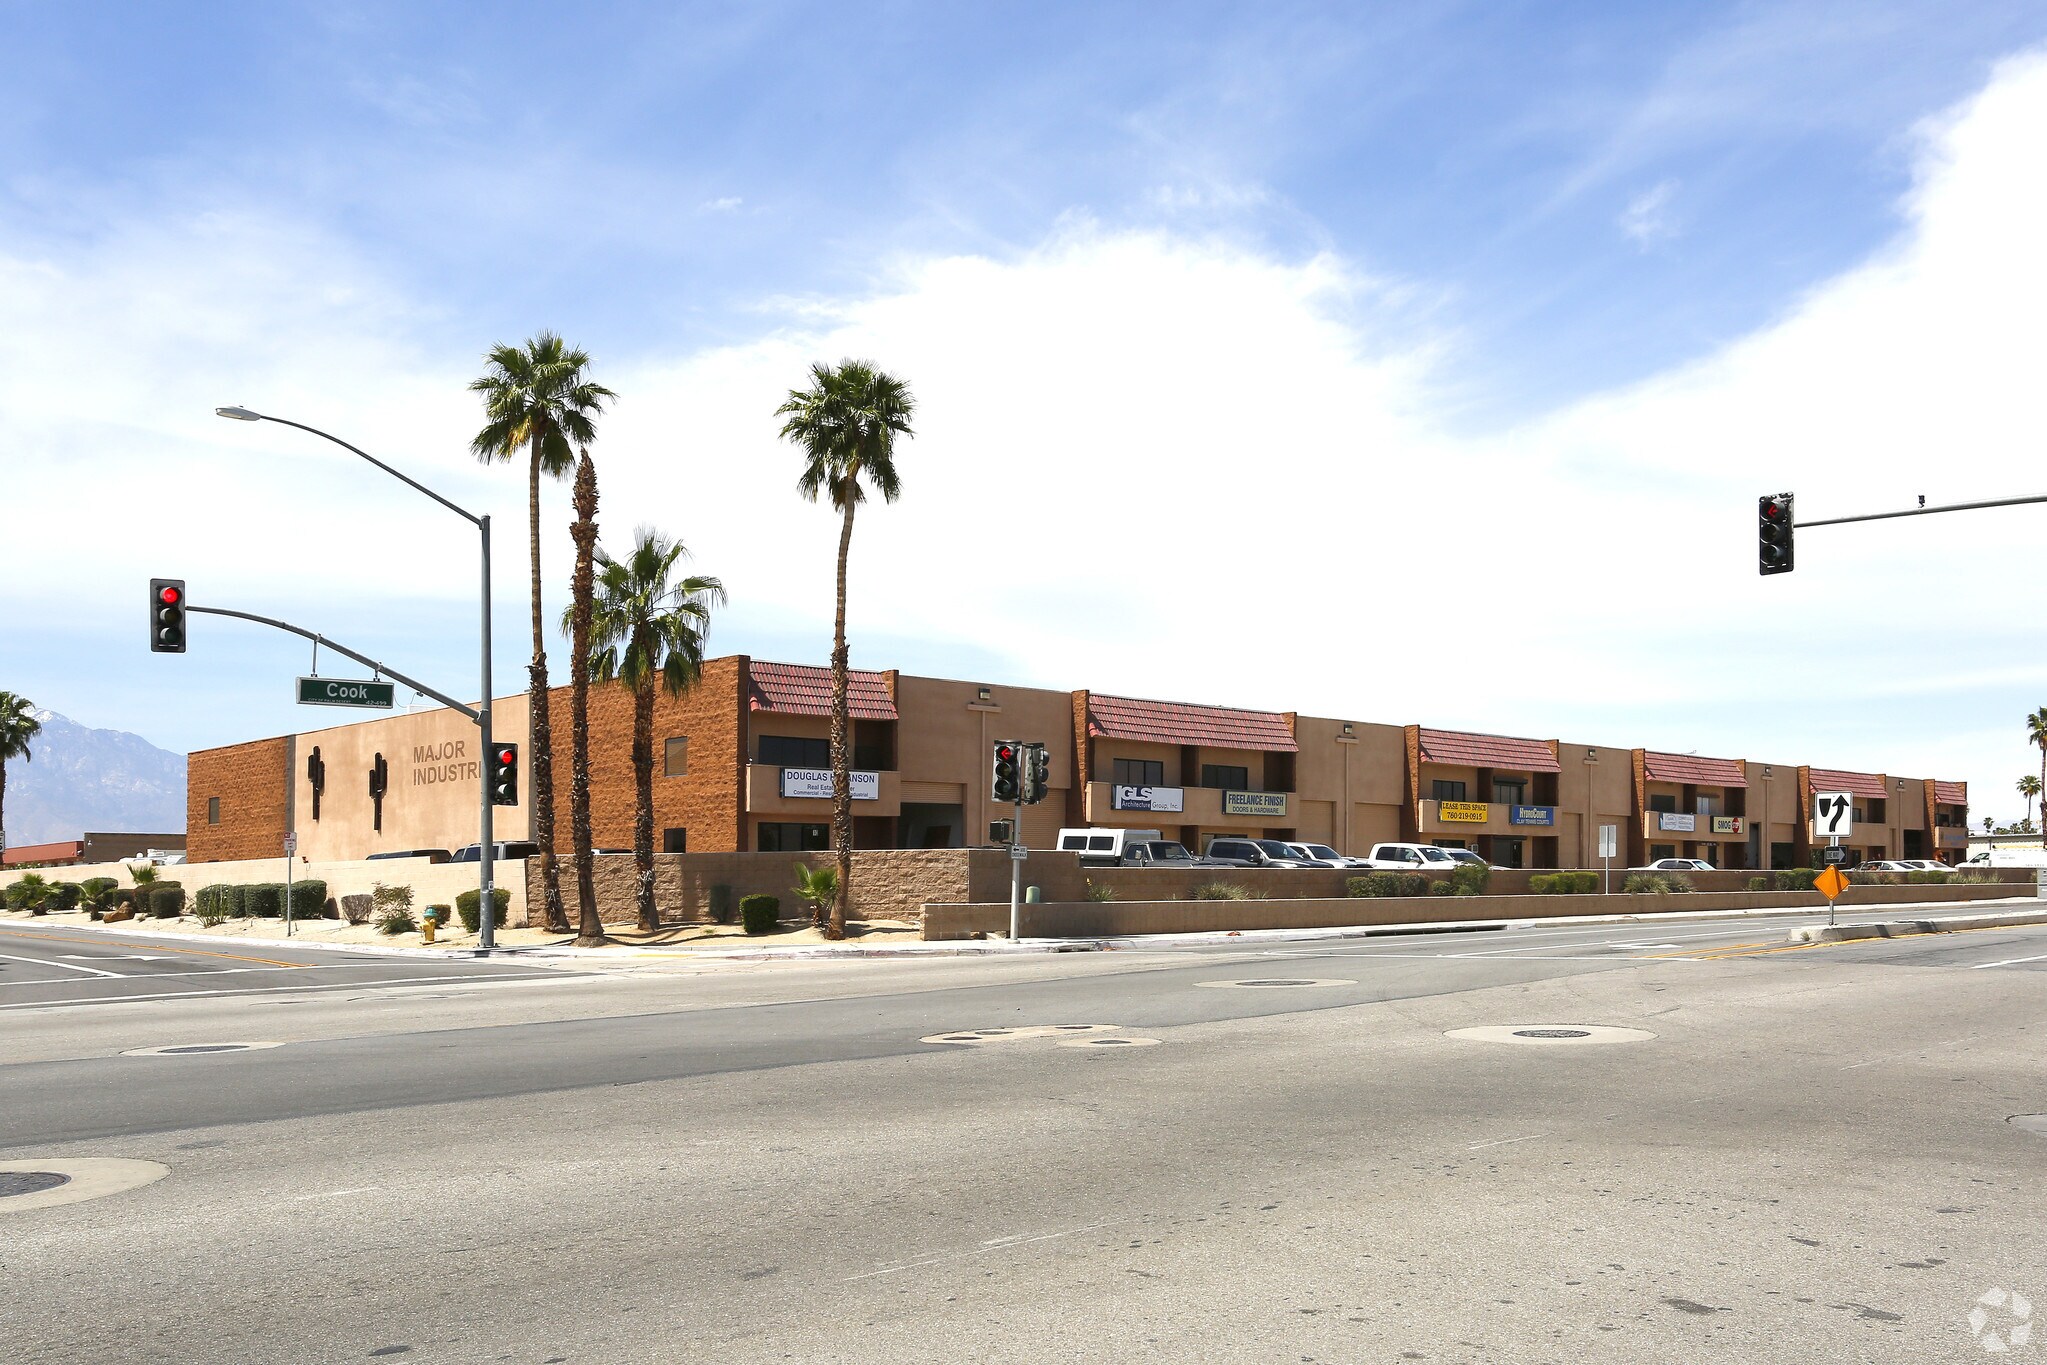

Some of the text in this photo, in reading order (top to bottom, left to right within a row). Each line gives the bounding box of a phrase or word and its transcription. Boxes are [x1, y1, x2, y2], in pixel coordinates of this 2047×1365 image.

[327, 683, 367, 698] Cook
[414, 741, 465, 763] MAJOR
[787, 771, 828, 781] DOUGLAS
[1121, 787, 1152, 801] GLS
[1228, 794, 1284, 806] FREELANCE FINISH
[1152, 802, 1169, 810] Group,
[1718, 820, 1731, 829] SMOG
